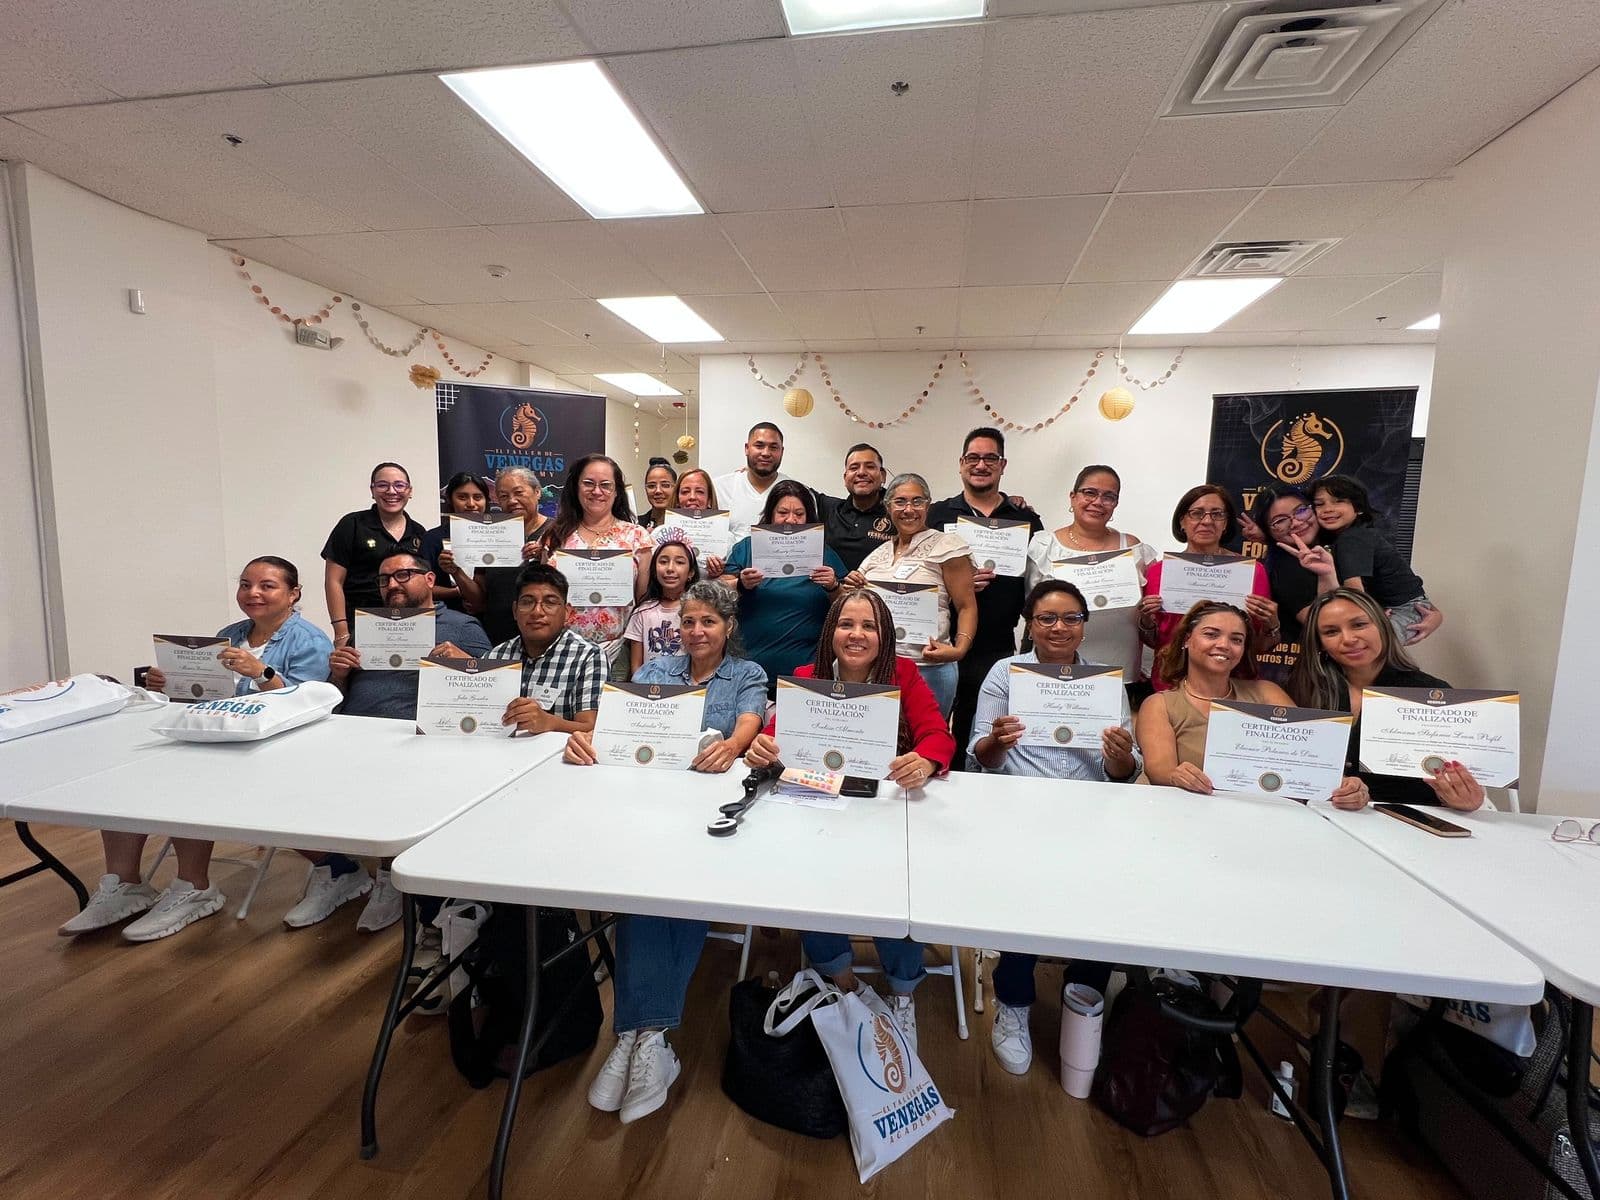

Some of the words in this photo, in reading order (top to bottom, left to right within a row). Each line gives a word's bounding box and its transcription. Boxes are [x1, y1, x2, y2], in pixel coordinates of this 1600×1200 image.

[484, 454, 564, 472] VENEGAS
[806, 700, 857, 710] CERTIFICADO
[1397, 707, 1461, 716] CERTIFICADO
[1241, 722, 1300, 734] CERTIFICADO
[893, 1089, 916, 1108] TALLER
[873, 1086, 940, 1138] VENEGAS
[890, 1109, 937, 1143] ACADEMY
